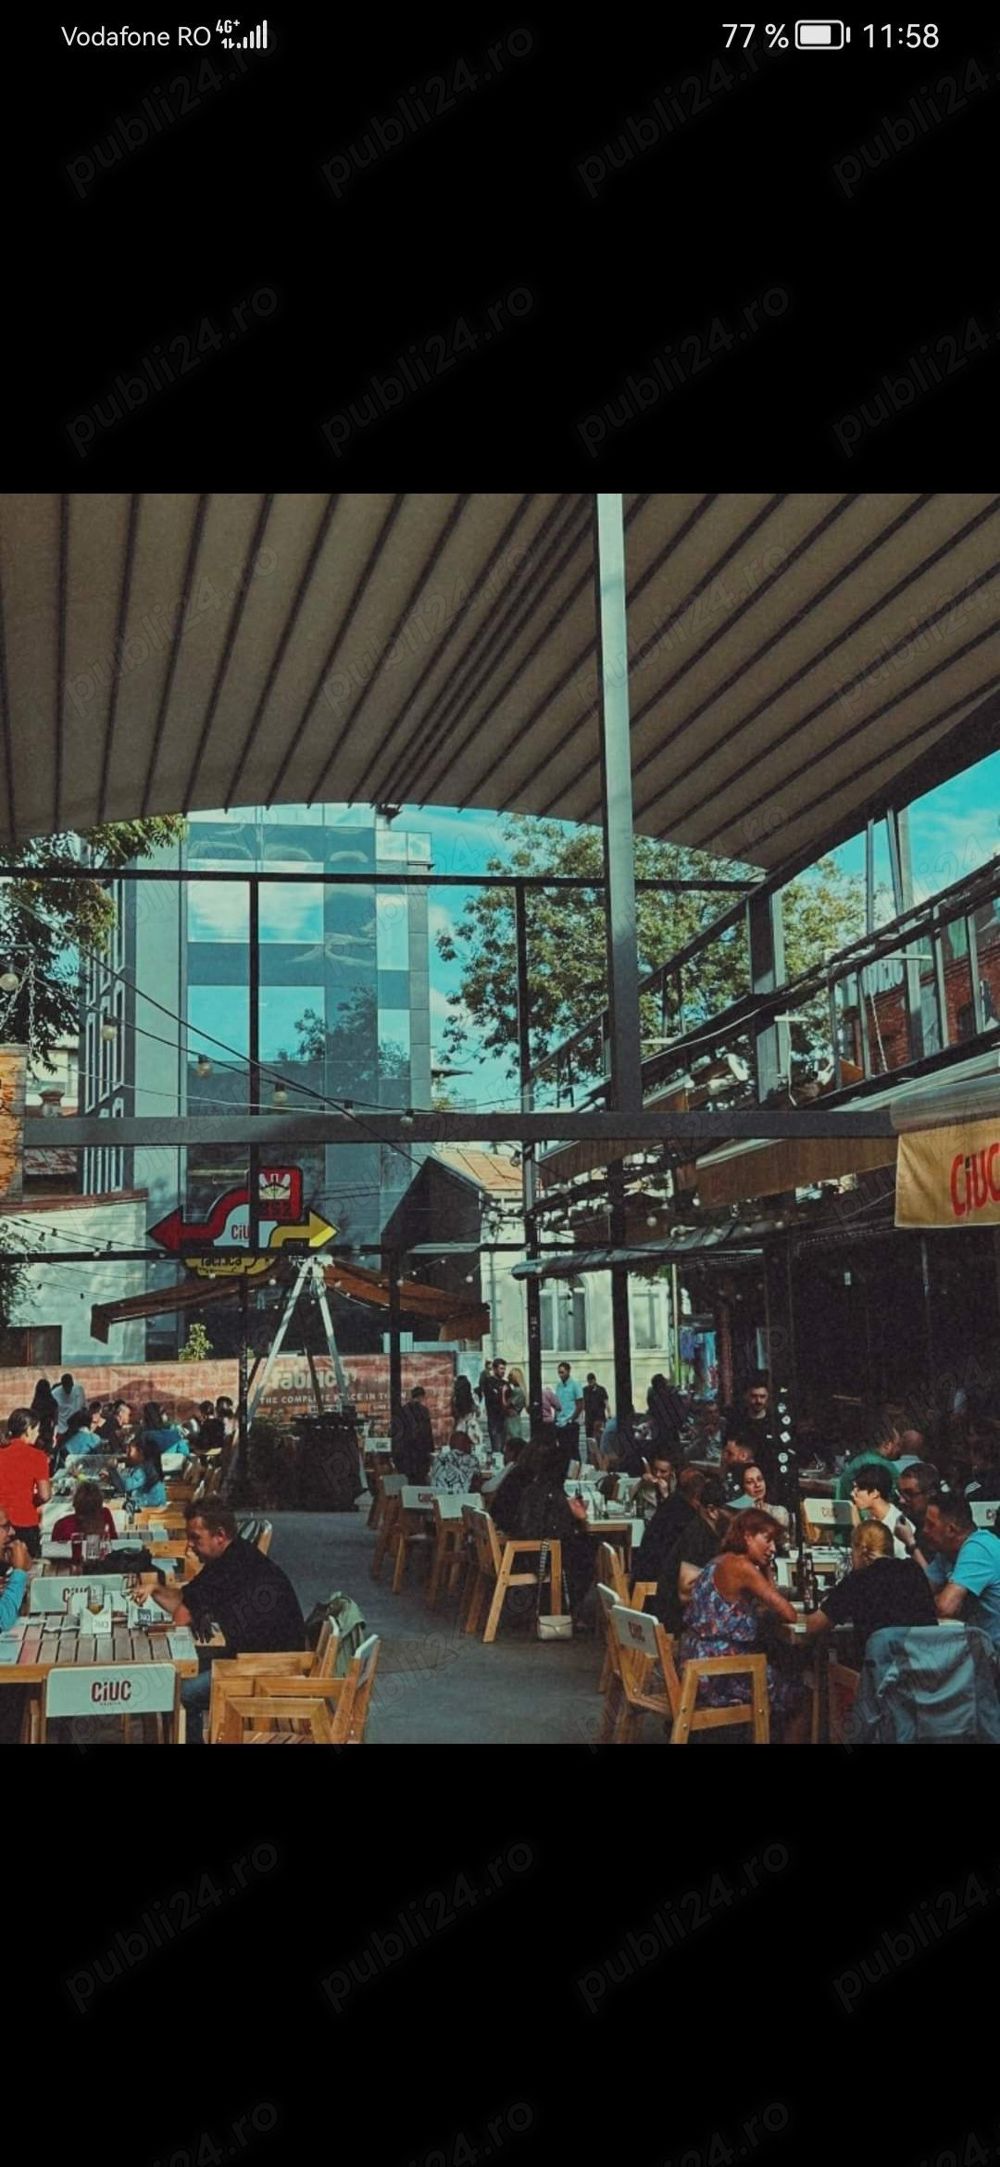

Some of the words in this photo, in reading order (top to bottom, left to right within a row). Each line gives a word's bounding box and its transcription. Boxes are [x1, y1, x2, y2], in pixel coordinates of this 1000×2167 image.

[231, 1223, 250, 1240] CiU
[260, 1396, 278, 1404] THE
[281, 1394, 331, 1404] COMPLTE
[91, 1680, 132, 1702] CiUC
